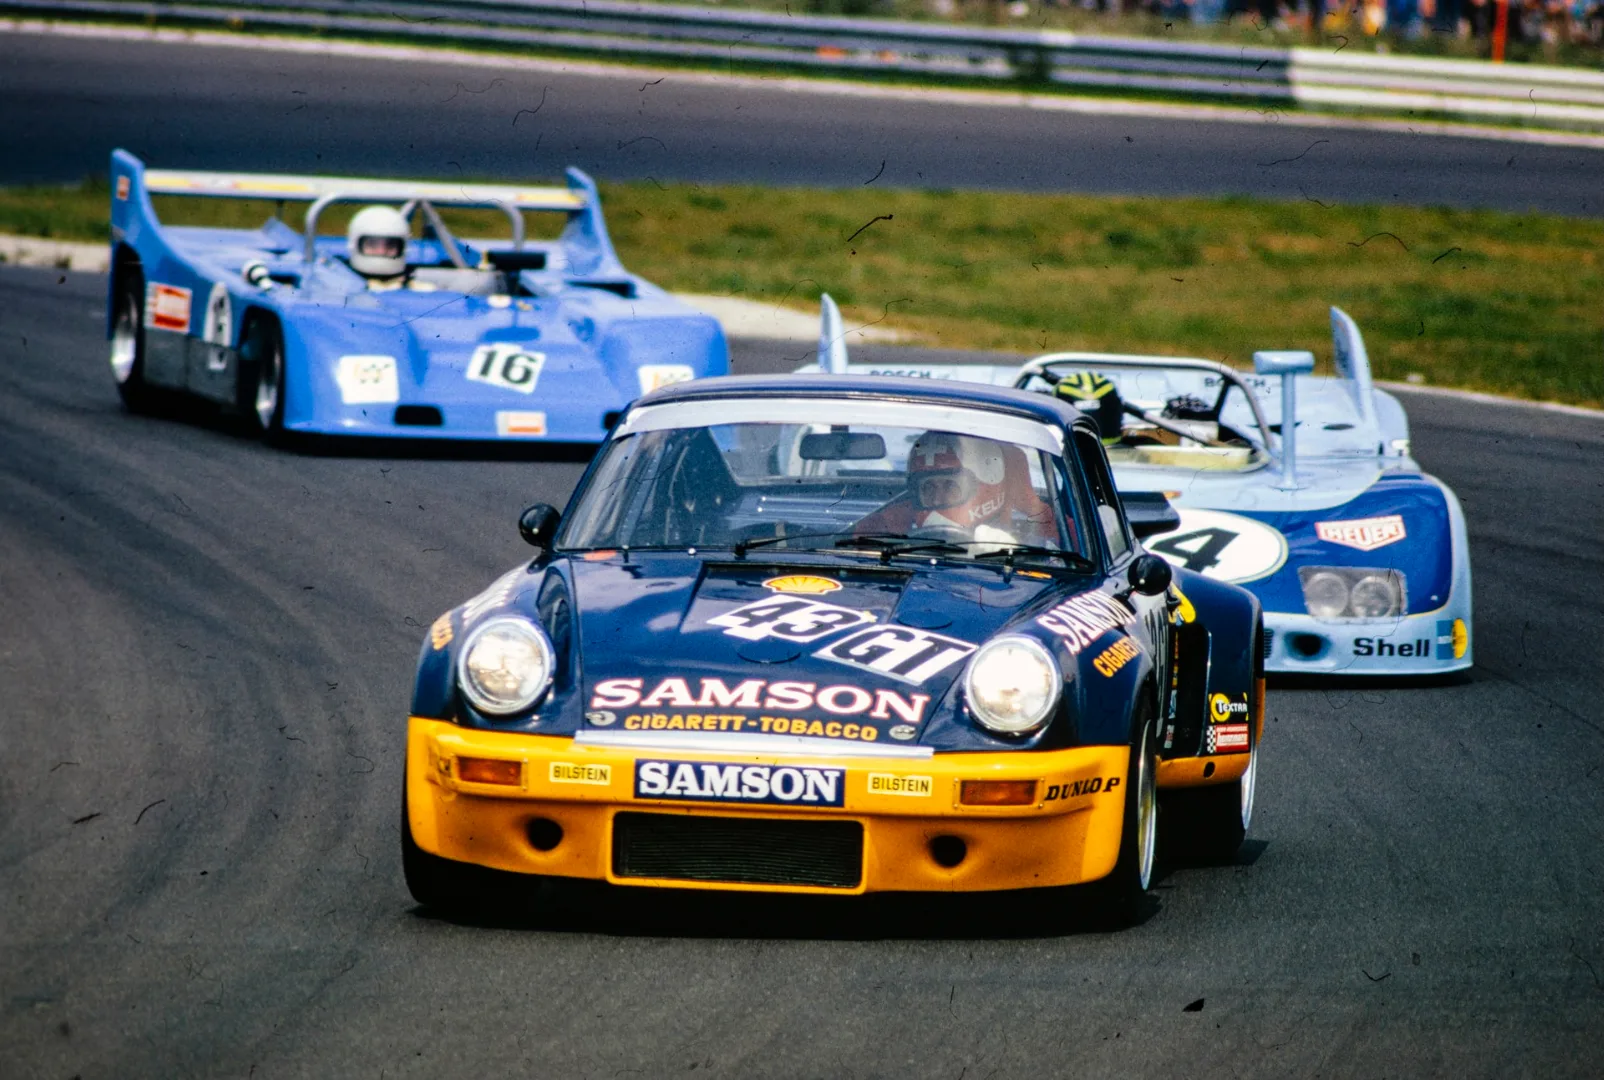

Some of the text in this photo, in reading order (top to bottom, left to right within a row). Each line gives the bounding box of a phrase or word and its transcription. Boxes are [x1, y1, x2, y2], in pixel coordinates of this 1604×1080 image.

[480, 350, 537, 385] 16
[1150, 527, 1240, 574] 4
[1319, 519, 1403, 547] HEUER
[728, 600, 861, 637] 43
[1036, 589, 1137, 656] SAMSON
[830, 627, 976, 677] GT
[1353, 637, 1430, 657] Shell
[591, 677, 931, 724] SAMSON
[624, 712, 878, 741] CIGARETT-TOBACCO
[553, 764, 609, 781] BILSTEIN
[639, 761, 840, 802] SAMSON
[872, 775, 930, 793] BILSTEIN
[1044, 777, 1120, 801] DUNLOP
